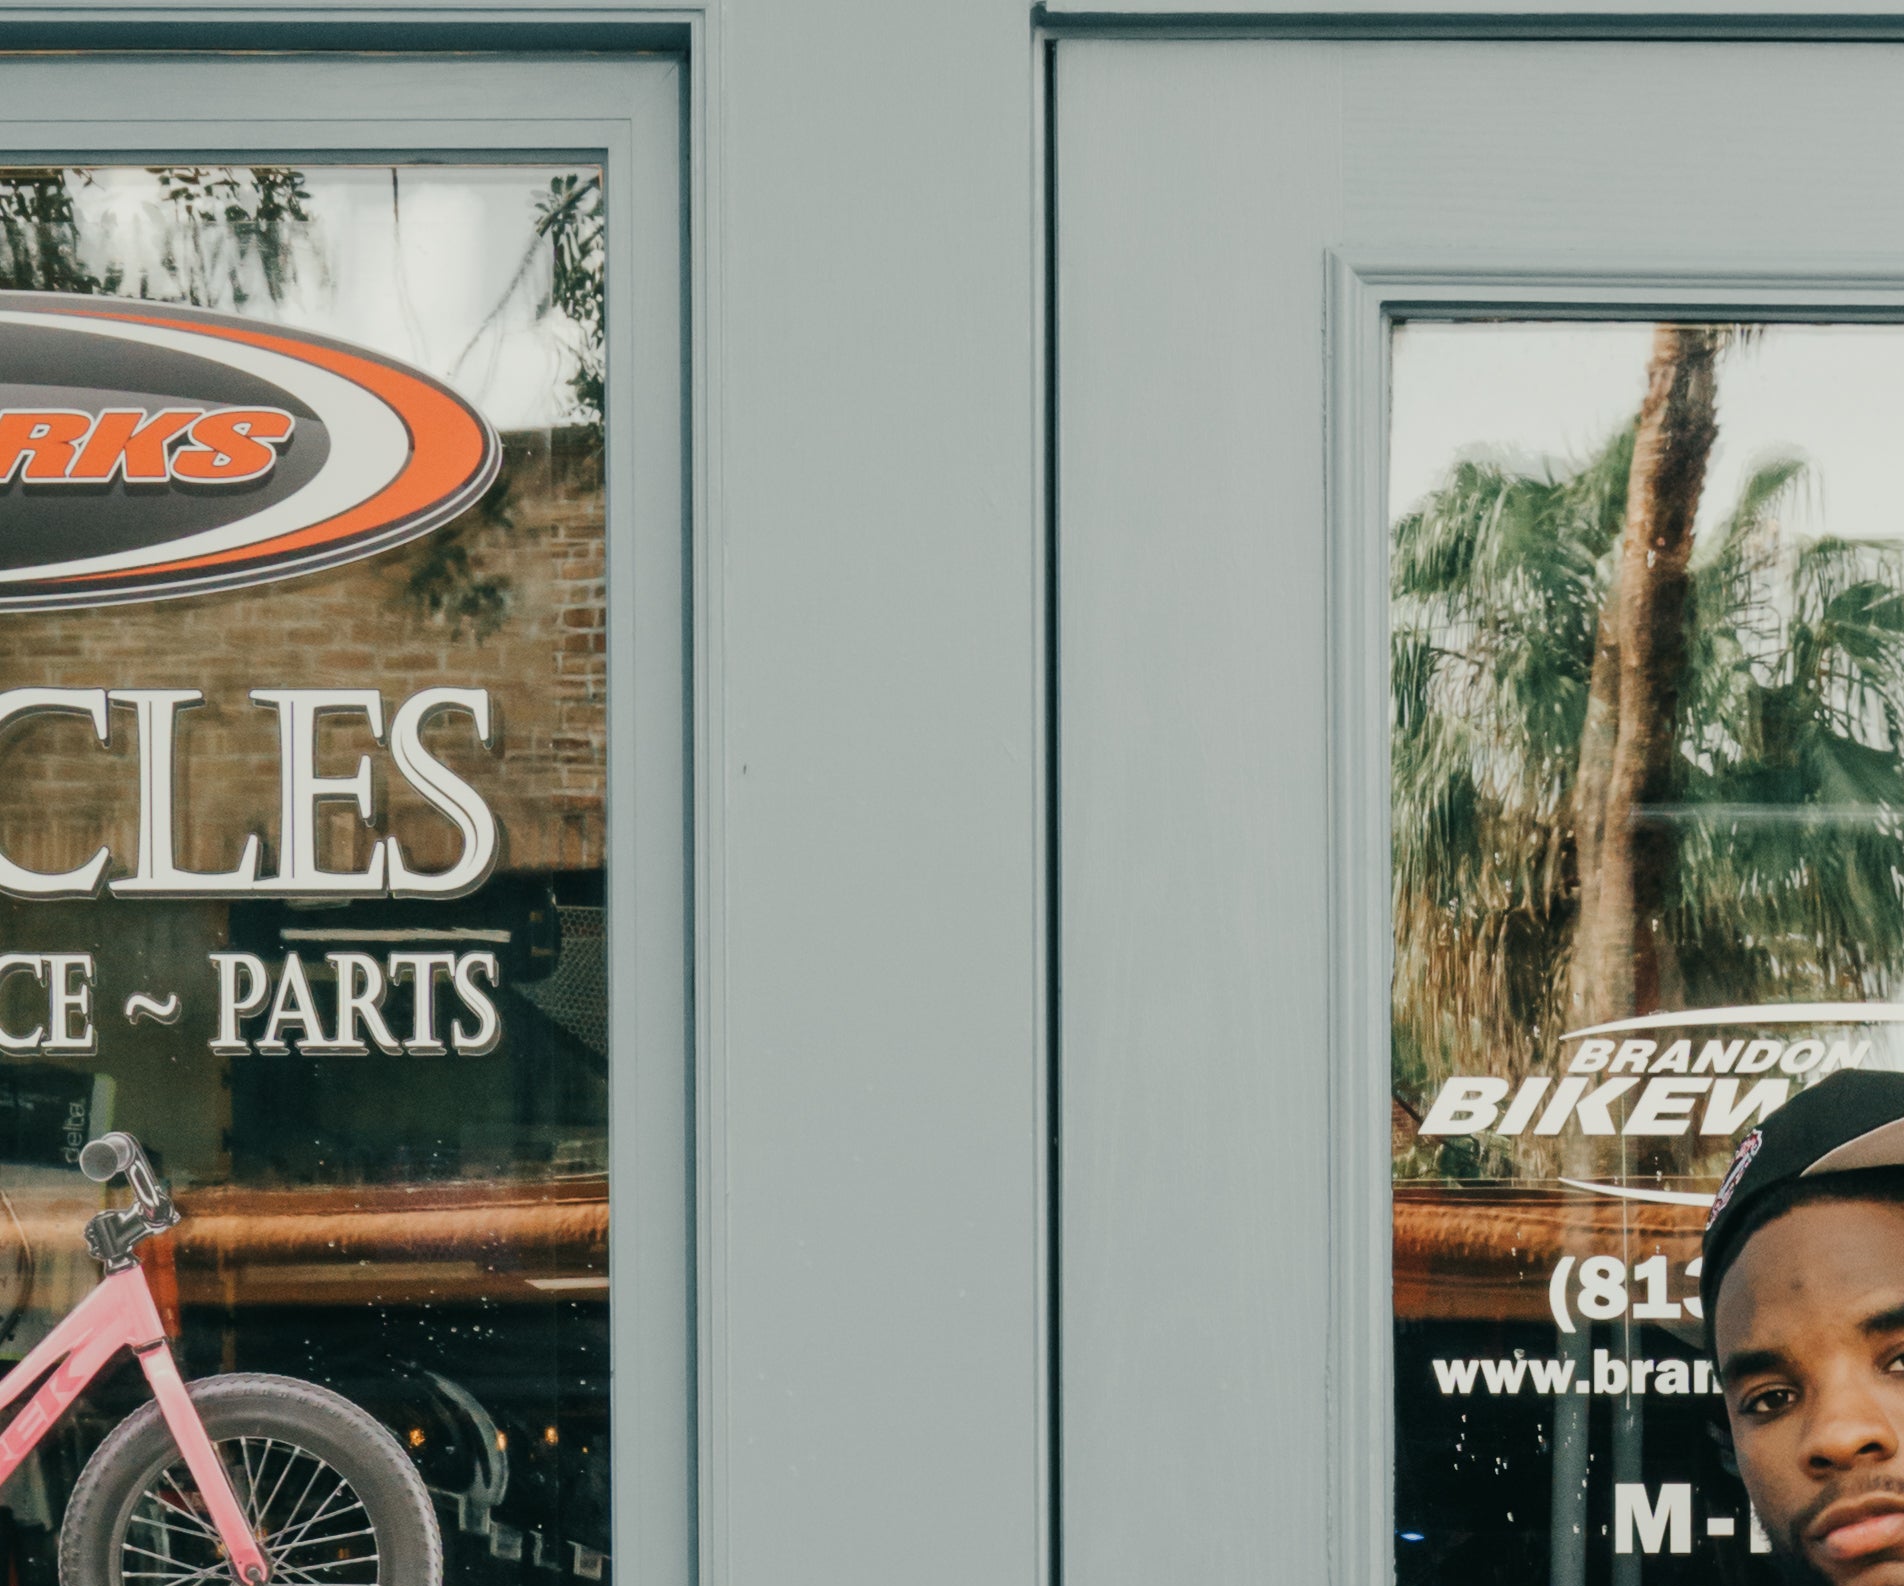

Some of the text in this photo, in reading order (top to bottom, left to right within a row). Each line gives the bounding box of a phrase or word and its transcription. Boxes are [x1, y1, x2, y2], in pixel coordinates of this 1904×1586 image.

[209, 951, 500, 1056] PARTS
[1567, 1038, 1872, 1074] BRANDON
[1615, 1483, 1692, 1554] M
